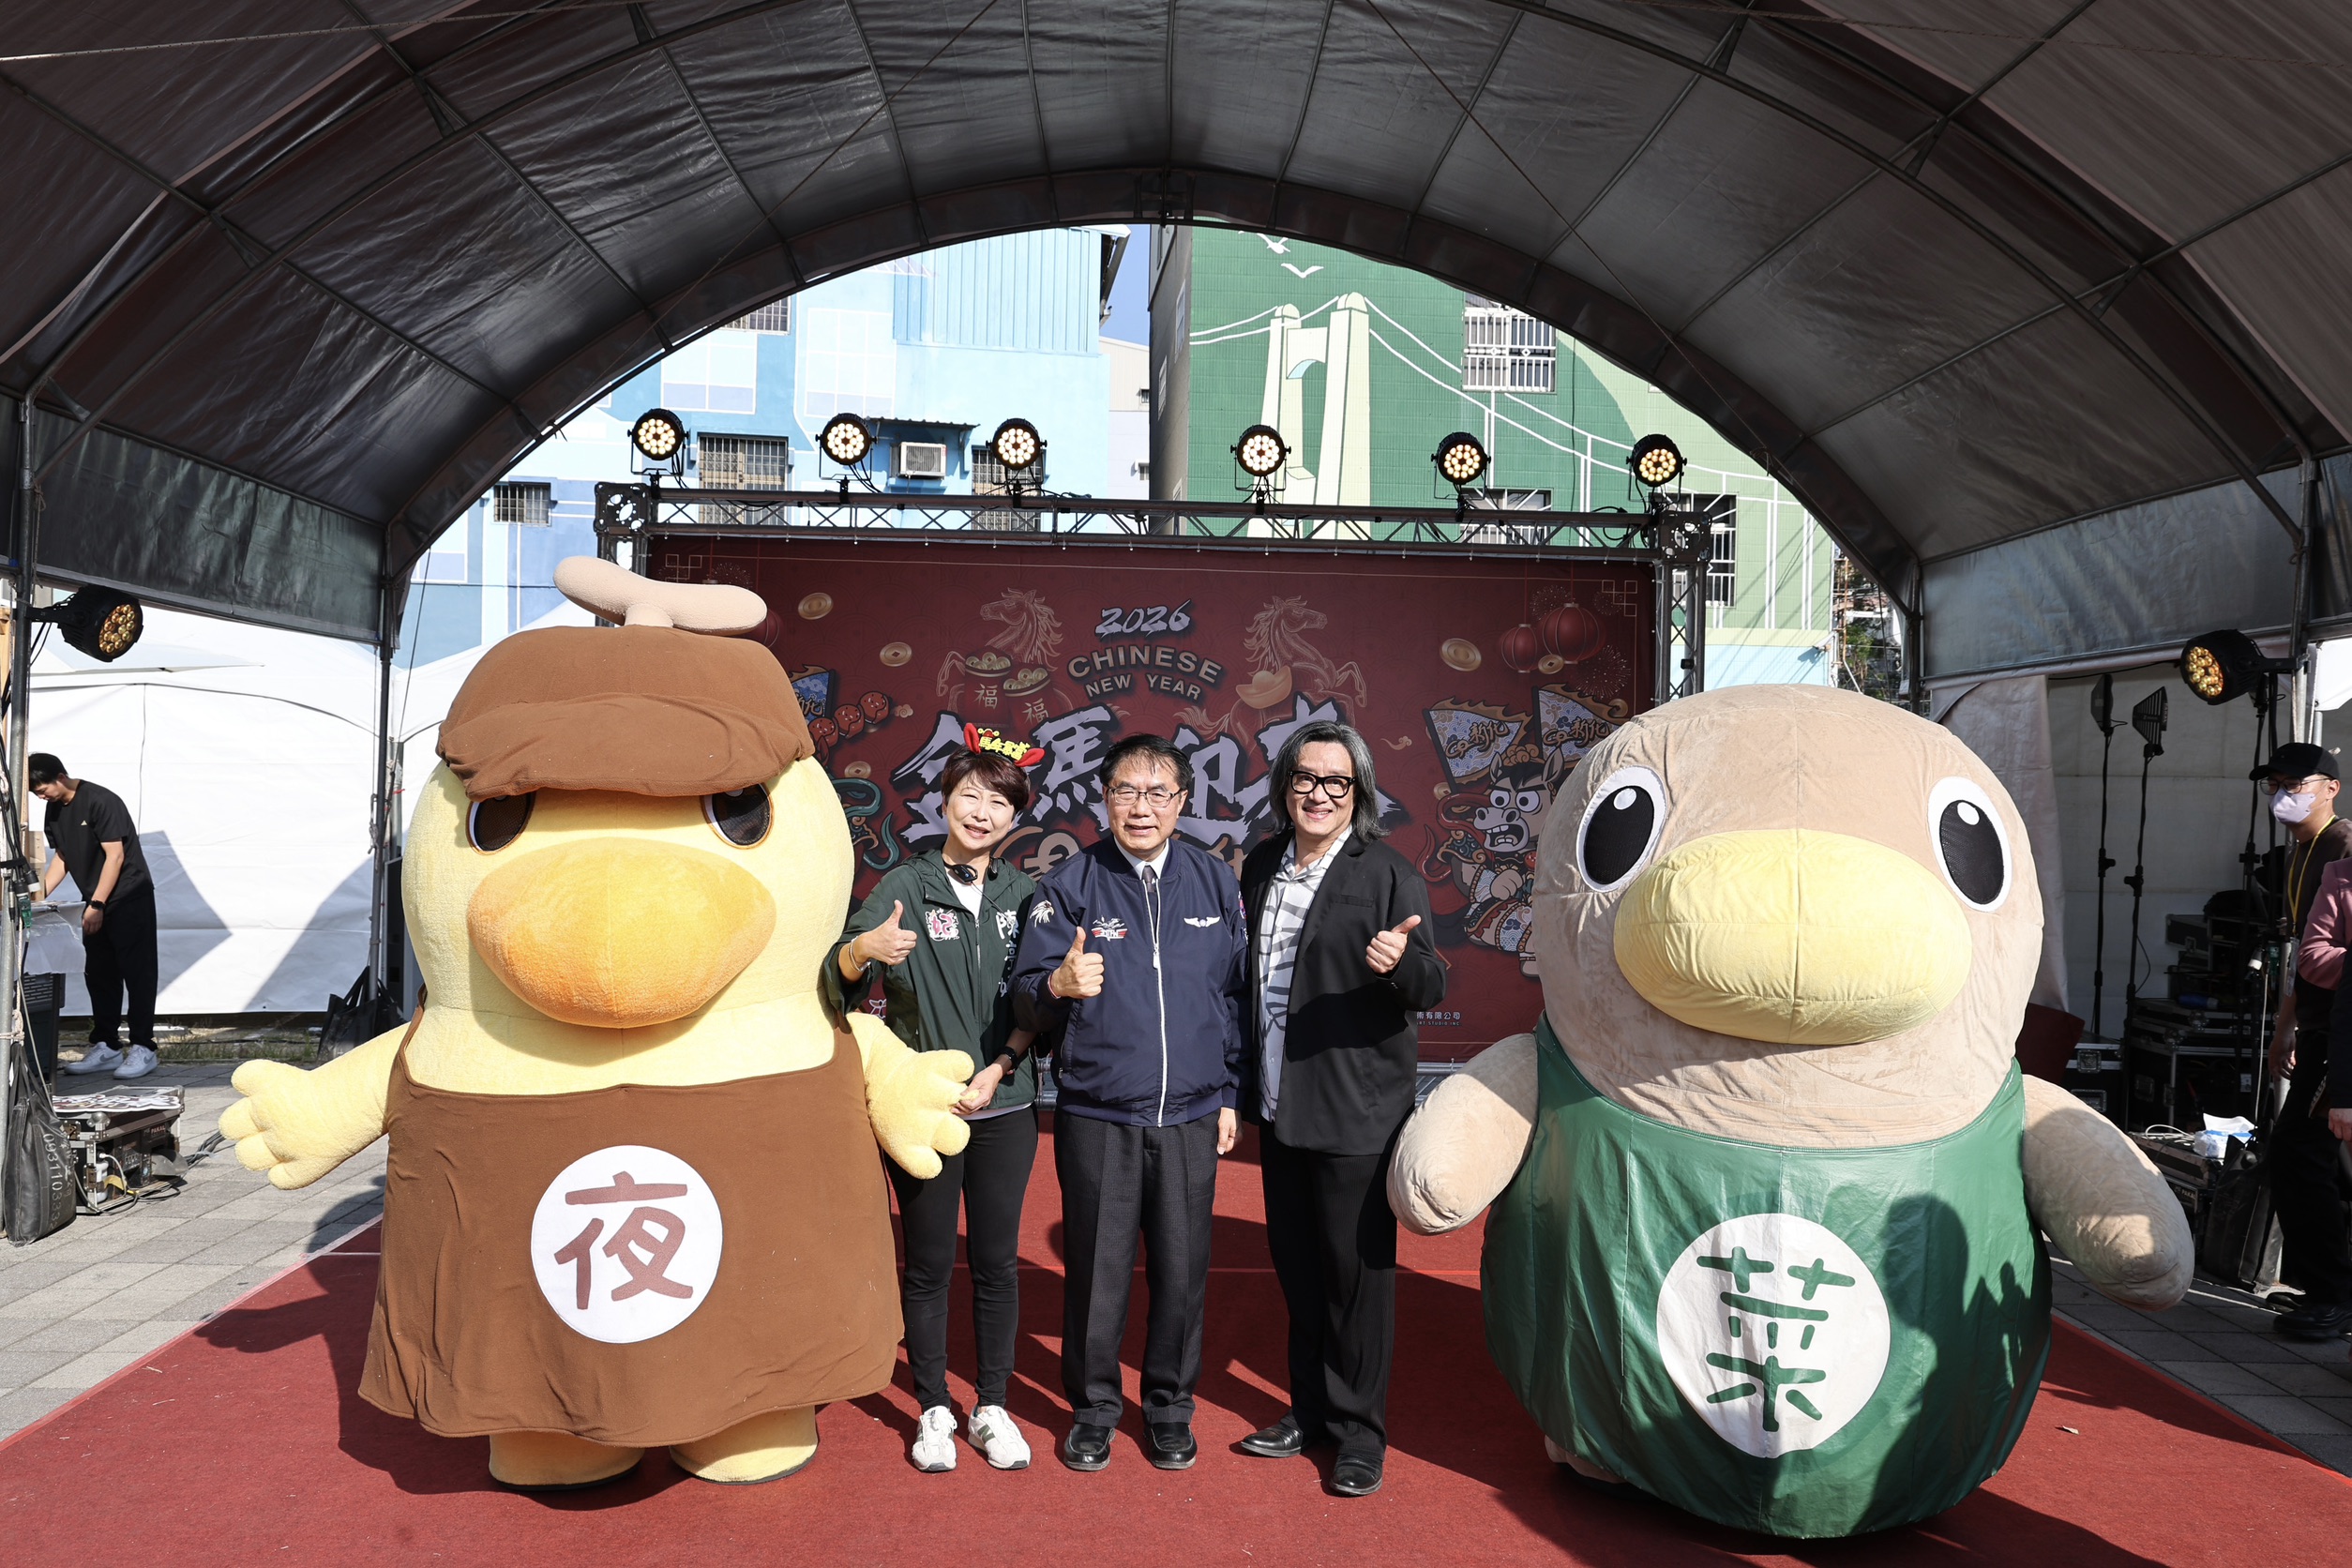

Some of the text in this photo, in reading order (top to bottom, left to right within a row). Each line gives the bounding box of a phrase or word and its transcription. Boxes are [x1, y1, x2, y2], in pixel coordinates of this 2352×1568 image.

[1094, 599, 1191, 639] 2026
[1068, 645, 1222, 684] CHINESE
[973, 683, 999, 710] 福
[1085, 673, 1201, 701] NEW YEAR
[1022, 698, 1050, 725] 福
[554, 1170, 693, 1310] 夜
[1696, 1246, 1856, 1432] 菜
